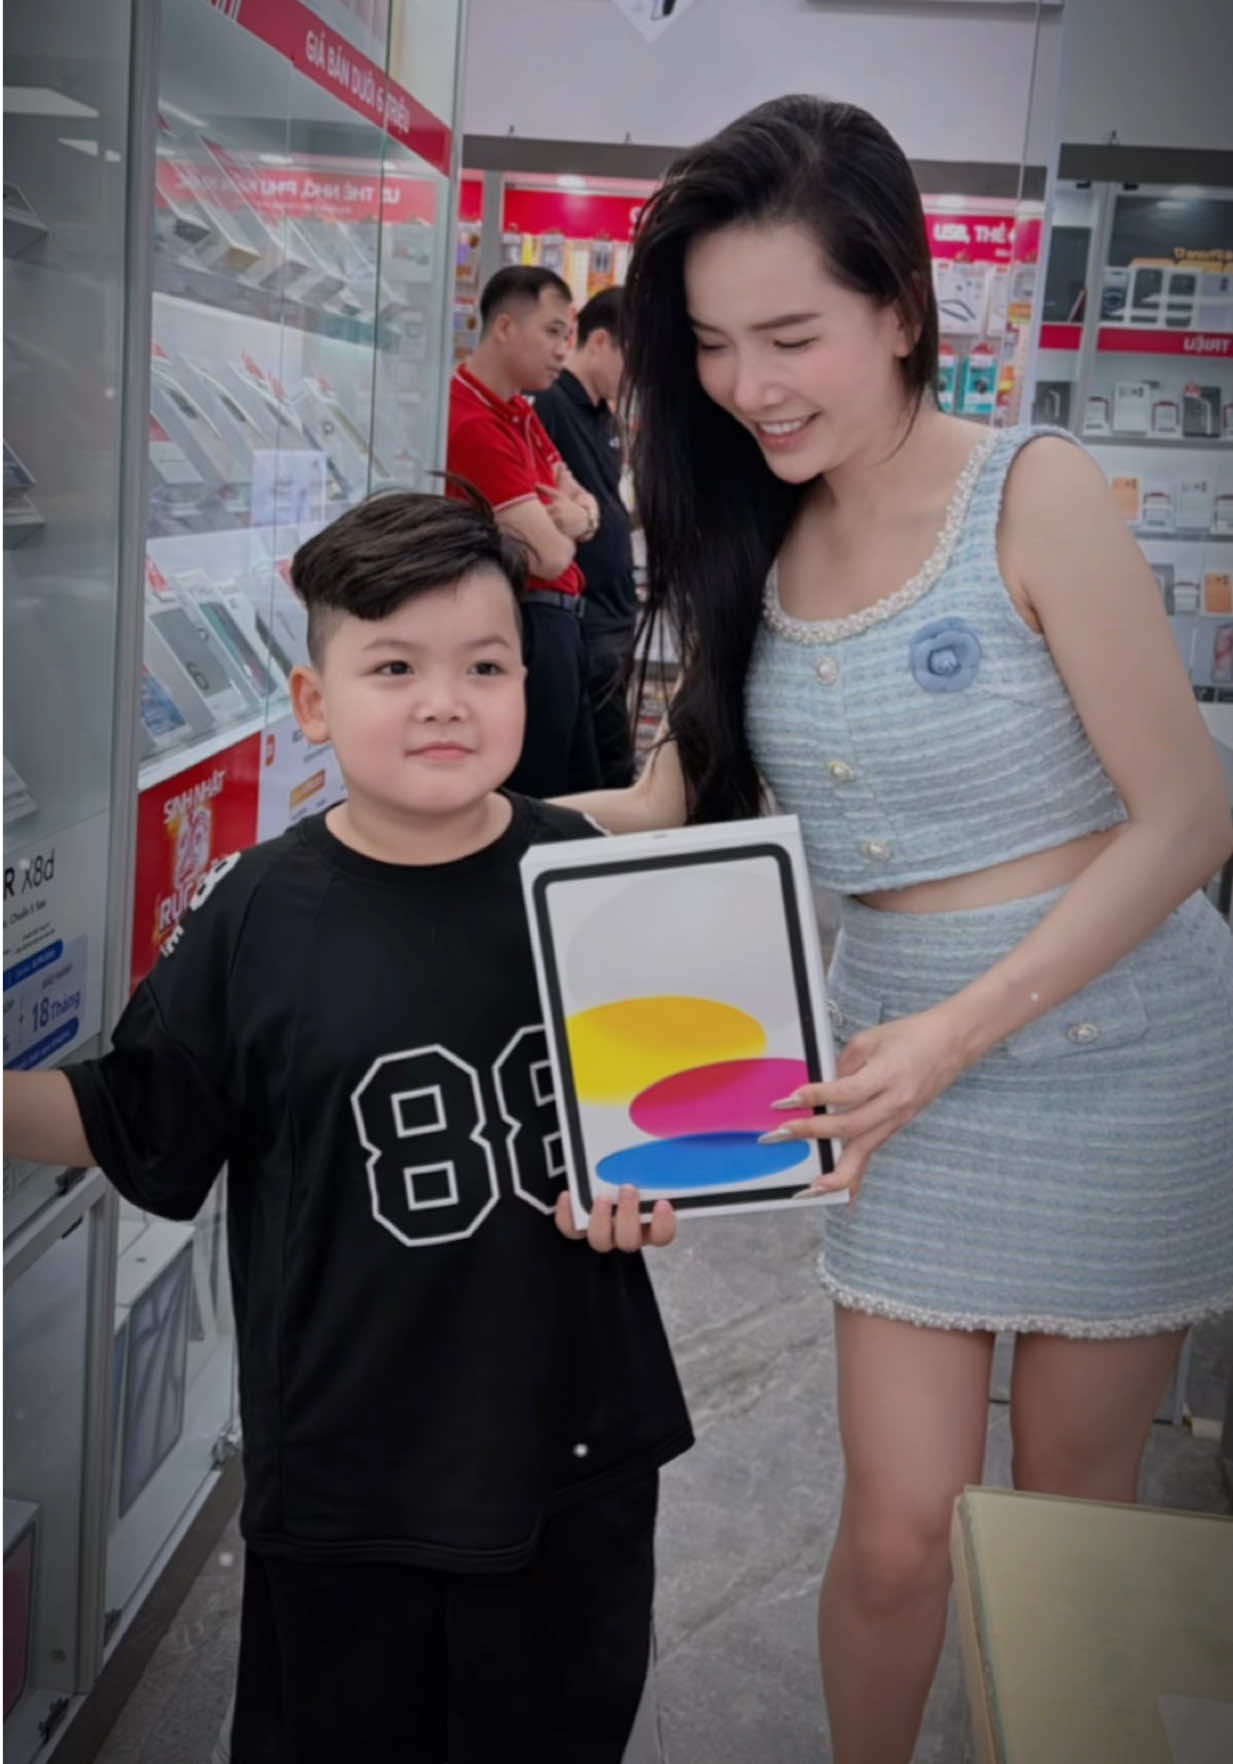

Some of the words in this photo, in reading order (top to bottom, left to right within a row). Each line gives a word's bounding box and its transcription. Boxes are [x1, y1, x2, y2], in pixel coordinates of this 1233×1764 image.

[306, 28, 325, 72] GIÁ
[327, 44, 350, 89] BÁN
[164, 789, 193, 824] SINH
[31, 996, 49, 1032] 18
